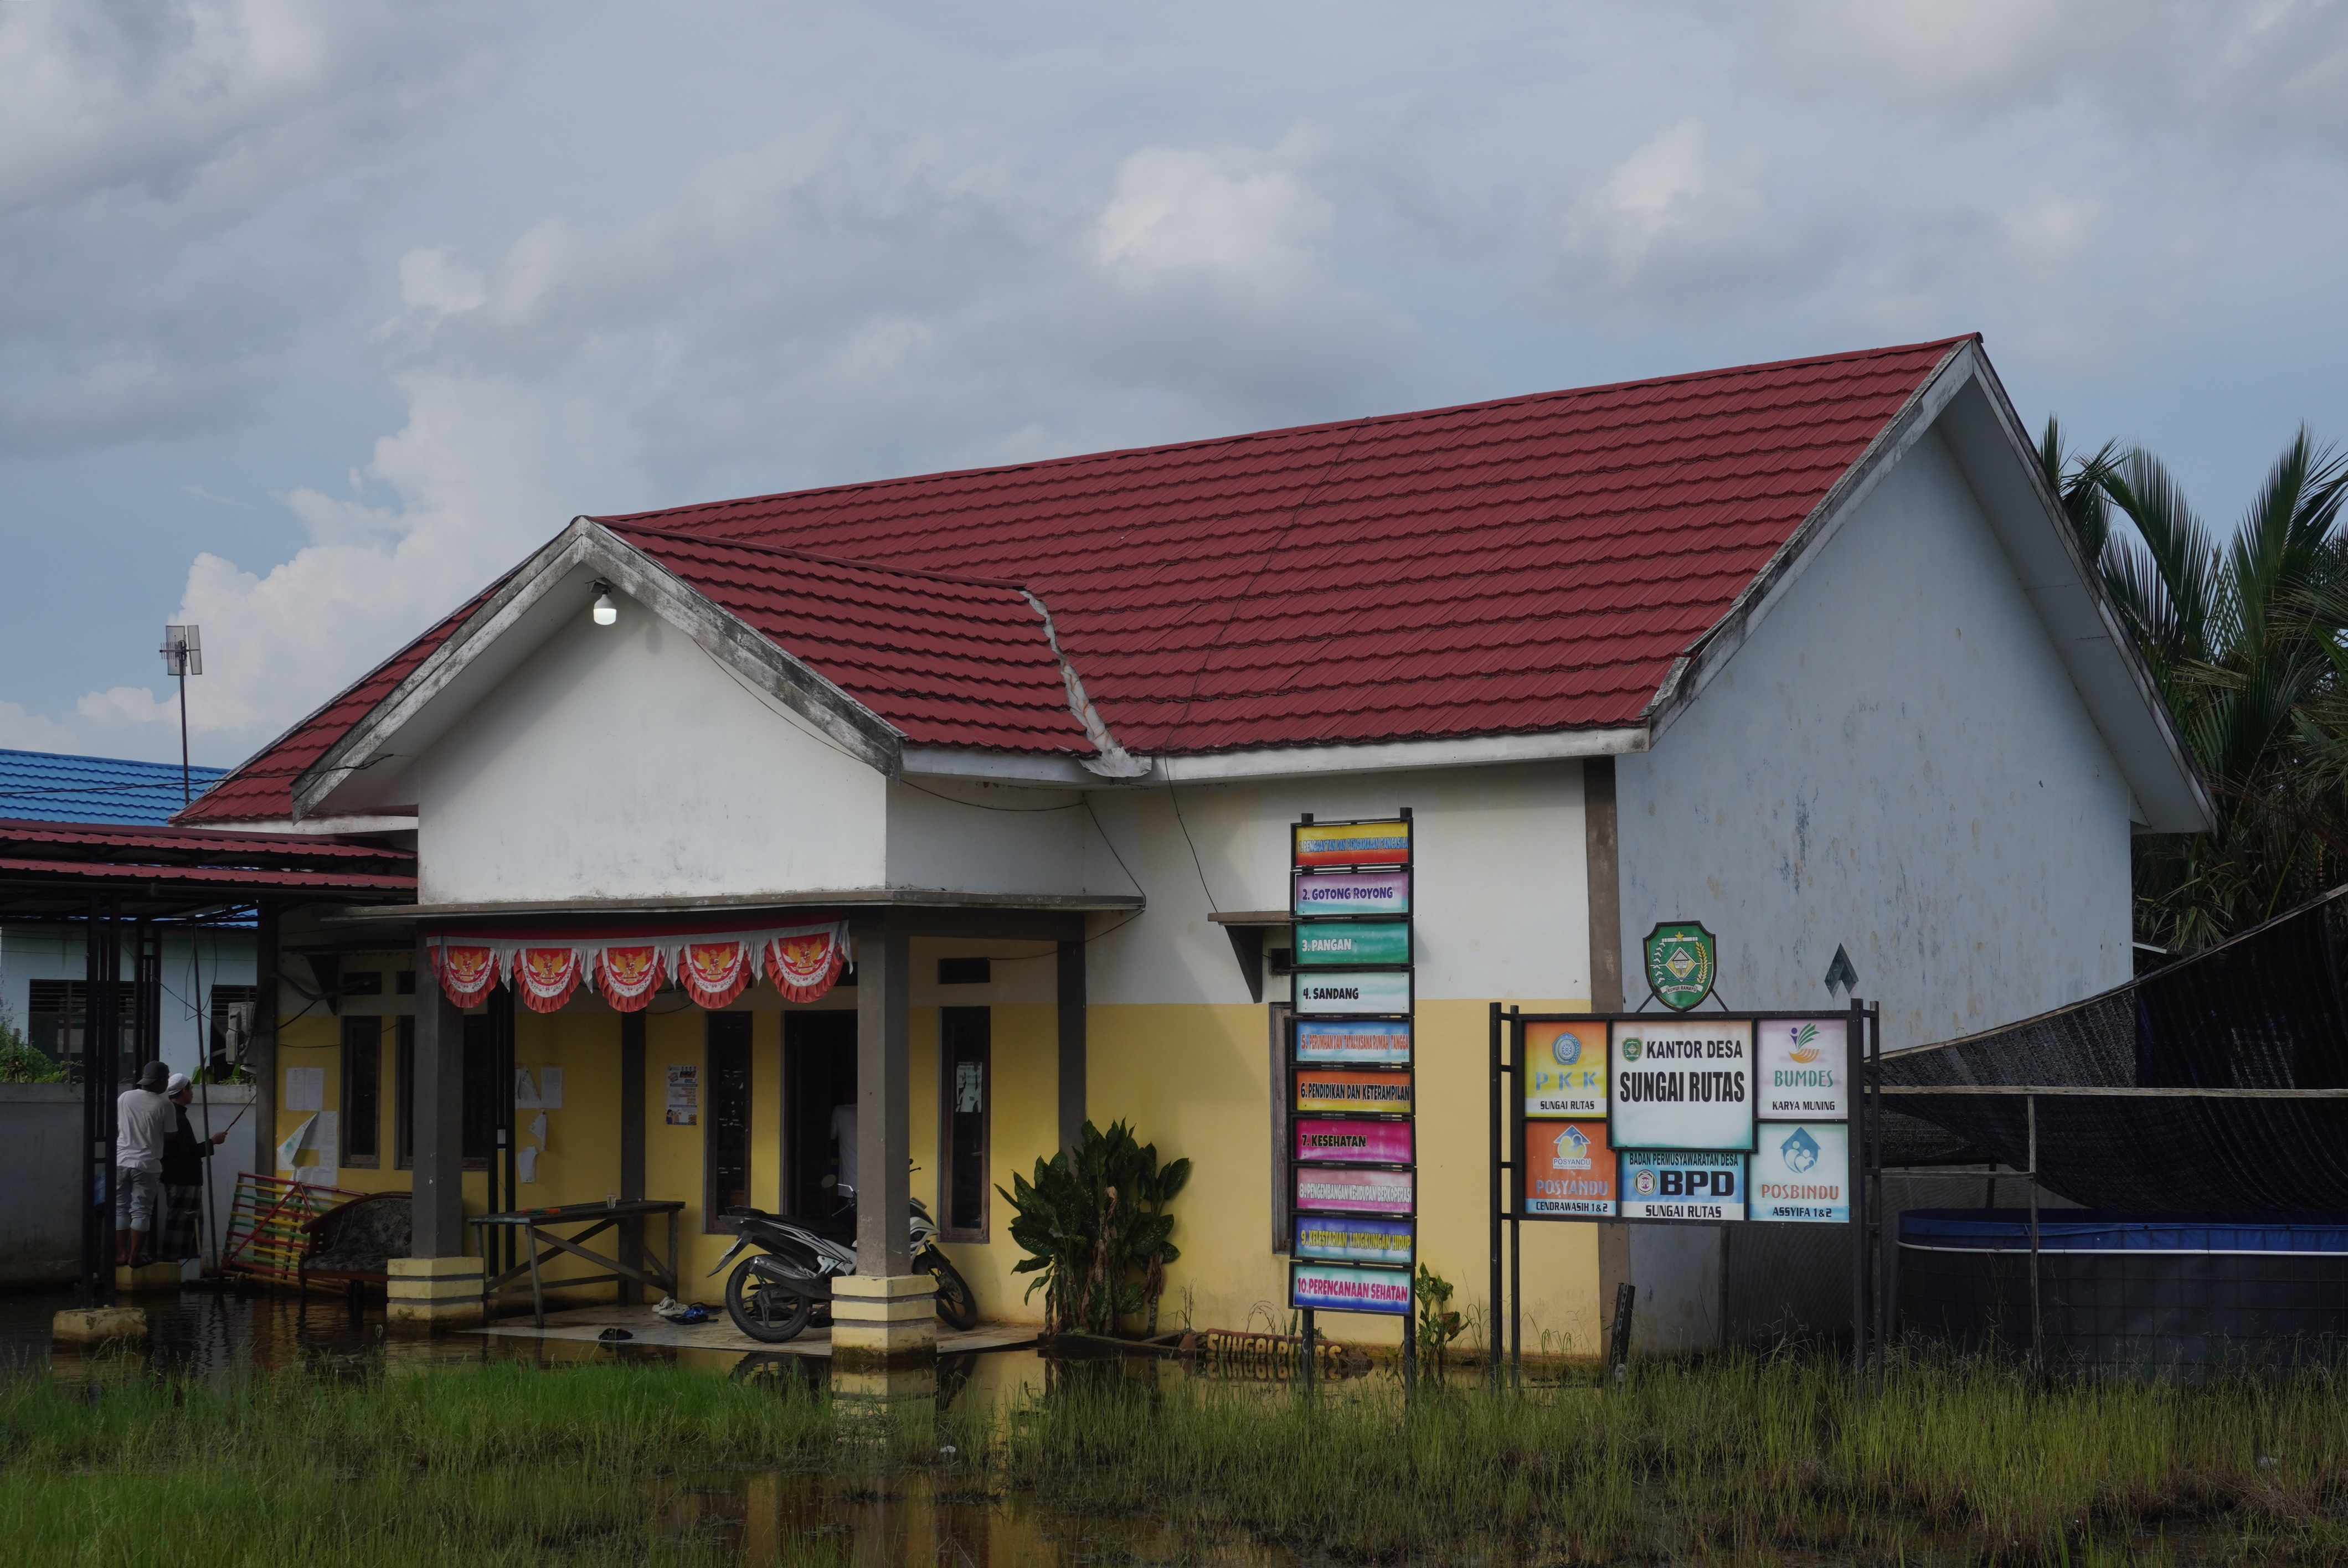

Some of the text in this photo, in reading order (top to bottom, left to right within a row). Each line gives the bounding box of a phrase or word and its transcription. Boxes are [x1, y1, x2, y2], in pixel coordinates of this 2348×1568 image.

[1337, 839, 1346, 851] DAN
[1347, 838, 1379, 850] PENGAMALAN
[1302, 886, 1393, 900] 2. GOTONG ROYONG
[1301, 938, 1352, 952] 3. PANGAN
[1303, 987, 1359, 999] 4. SANDANG
[1301, 1034, 1308, 1050] 5.
[1373, 1034, 1389, 1050] RUMAH
[1391, 1034, 1409, 1050] TANGGA
[1647, 1040, 1743, 1059] KANTOR DESA
[1774, 1070, 1834, 1087] BUMDES
[1347, 1084, 1361, 1100] DAN
[1362, 1084, 1410, 1101] KETERAMPILAN
[1620, 1071, 1744, 1102] SUNGAI RUTAS
[1541, 1101, 1595, 1110] SUNGAI RUTAS
[1773, 1101, 1835, 1111] KARYA MUNING
[1301, 1134, 1367, 1147] 7. KESEHATAN
[1630, 1153, 1738, 1166] BADAN PERMUSYAWARATAN DESA
[1536, 1179, 1608, 1196] POSYANDU
[1660, 1170, 1734, 1196] BPD
[1349, 1184, 1376, 1201] KEHIDUPAN
[1377, 1185, 1412, 1203] BERKOPERASI
[1762, 1184, 1839, 1200] POSBINDU
[1536, 1201, 1589, 1212] CENDRAWASIH
[1646, 1205, 1721, 1218] SUNGAI RUTAS
[1772, 1207, 1811, 1217] ASSYIFA
[1350, 1231, 1391, 1250] LINGKUNGAN
[1392, 1234, 1411, 1251] HIDUP
[1371, 1283, 1408, 1302] SEHATAN
